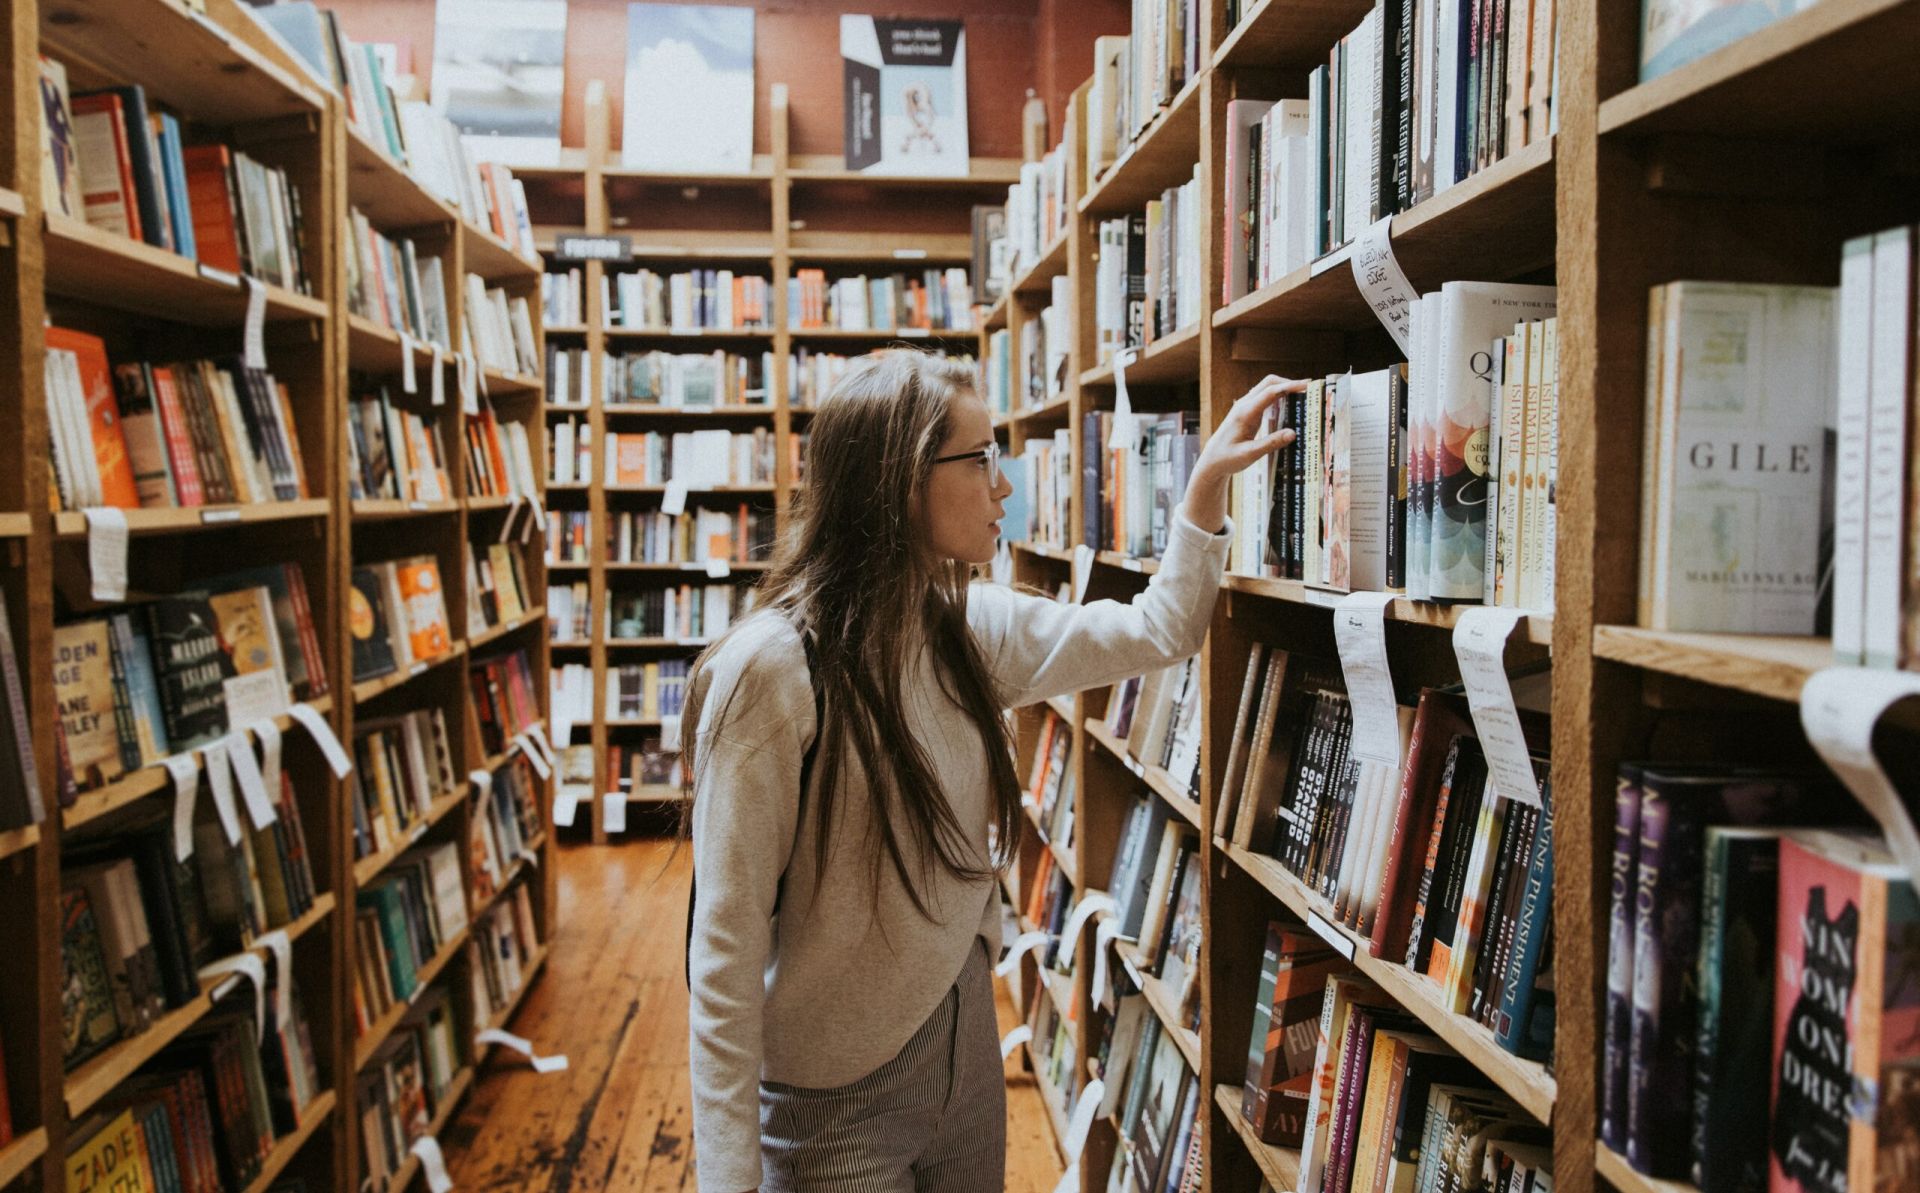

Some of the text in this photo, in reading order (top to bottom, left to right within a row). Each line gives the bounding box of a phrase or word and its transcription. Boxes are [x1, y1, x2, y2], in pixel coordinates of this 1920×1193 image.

[1398, 0, 1411, 201] HOMAS PYNCHON BLEEDING EDGE
[1371, 119, 1381, 175] BLEEDING
[1370, 178, 1379, 207] EDGE
[1390, 374, 1398, 436] Monument
[1509, 383, 1522, 454] ISHMAEL
[1526, 385, 1538, 456] ISHMAEL
[1539, 383, 1552, 455] ISHMAEL
[1389, 437, 1397, 468] Road
[1689, 442, 1811, 474] GILE
[53, 666, 81, 686] GE
[59, 696, 90, 716] ANE
[1294, 768, 1316, 842] OTARED
[1301, 772, 1323, 846] OTARED
[1527, 813, 1537, 834] WHY
[1502, 818, 1515, 854] RAKHA
[1520, 843, 1531, 867] CAME
[1481, 891, 1500, 957] CROCODILES
[1633, 861, 1660, 947] ROSE
[1502, 877, 1541, 1006] PUNISHMENT
[1799, 912, 1850, 969] NIN
[1782, 953, 1860, 1025] WOM
[1346, 1038, 1363, 1110] UNRESTORED
[1784, 1049, 1851, 1126] DRES
[1339, 1113, 1352, 1155] WOMAN
[1381, 1118, 1391, 1144] RASH
[1386, 1094, 1395, 1115] RON
[74, 1126, 134, 1193] ZADIE
[1373, 1146, 1386, 1187] READER
